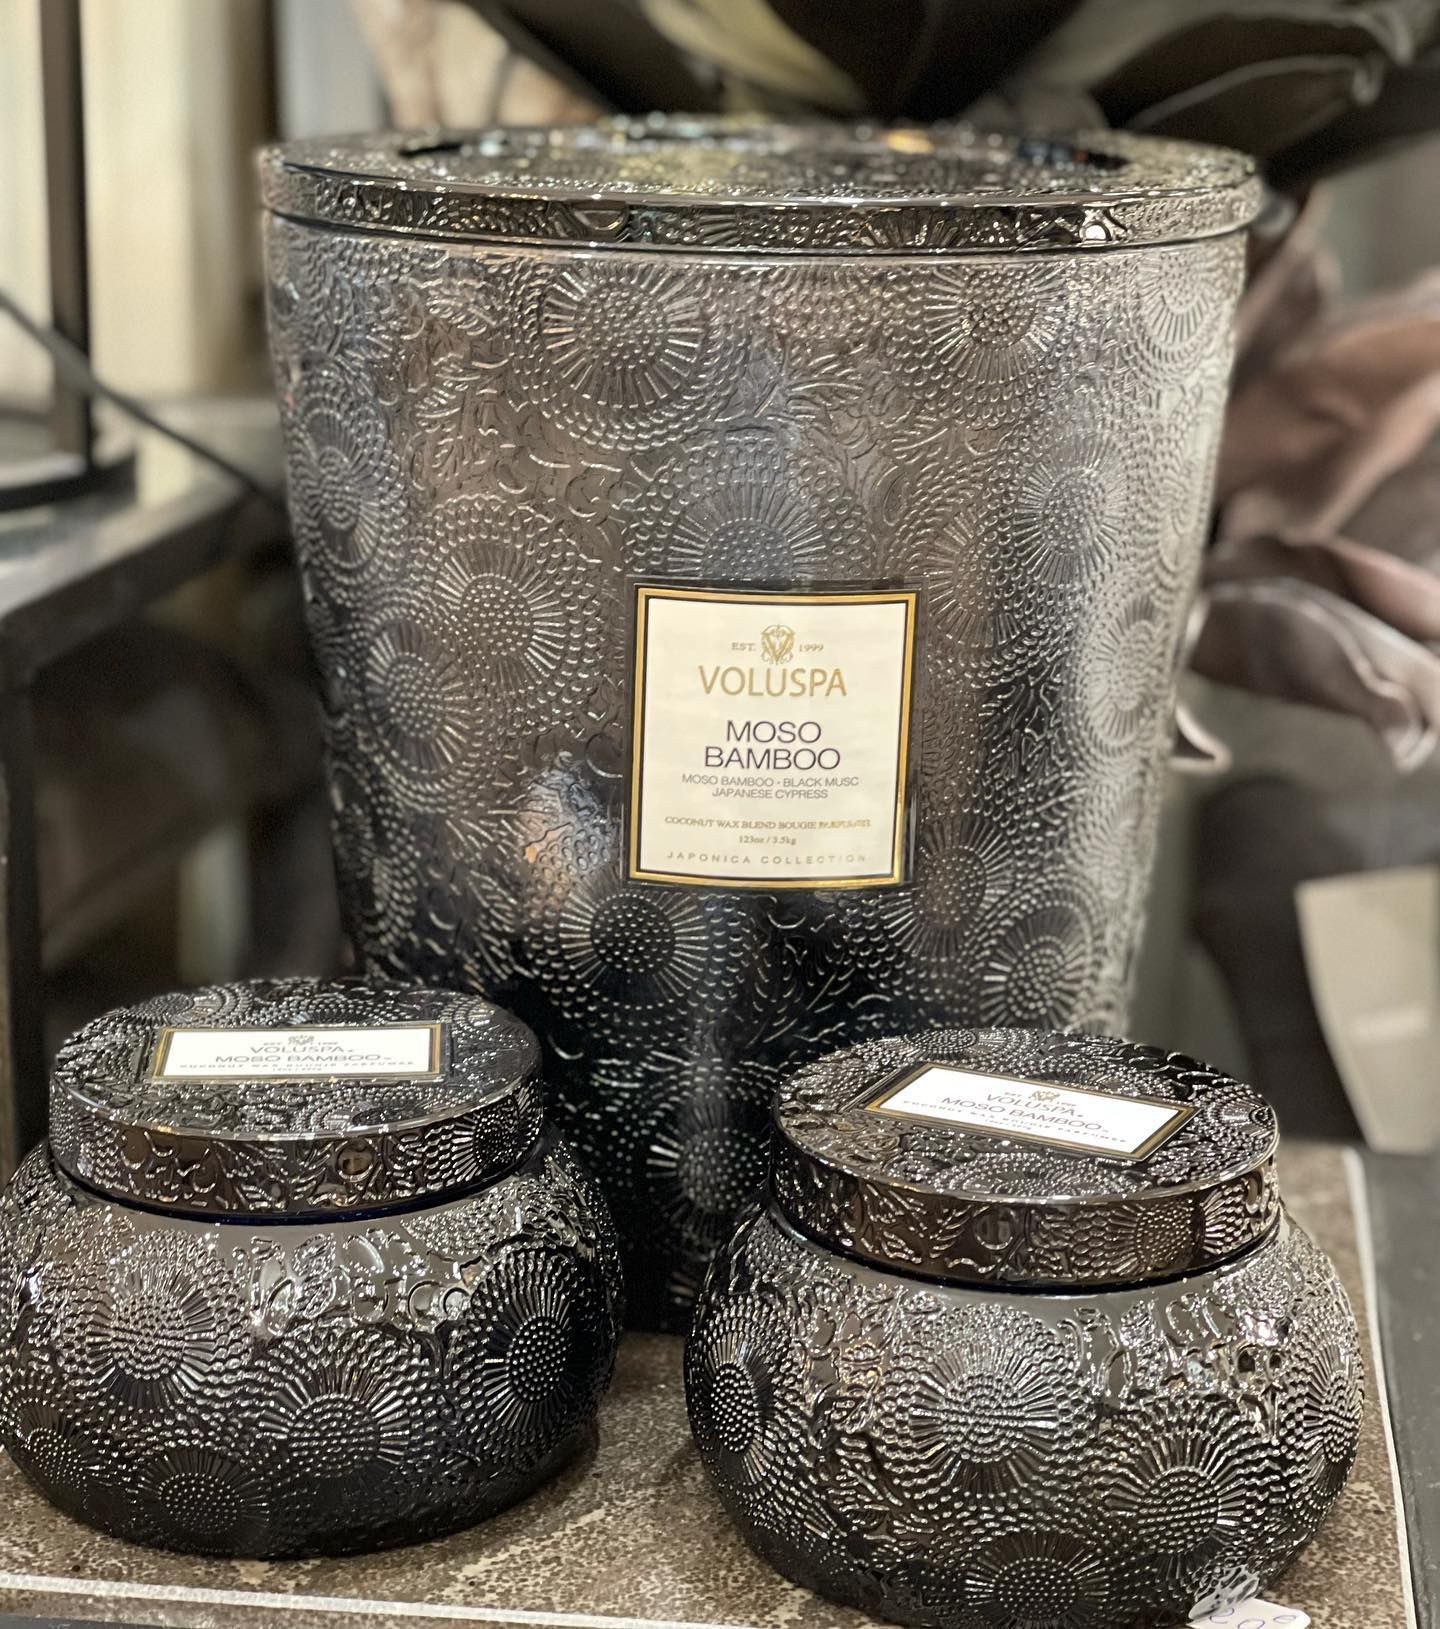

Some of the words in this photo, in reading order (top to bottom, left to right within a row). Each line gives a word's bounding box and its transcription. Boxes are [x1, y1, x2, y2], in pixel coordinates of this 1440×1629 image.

[799, 643, 824, 652] 1999
[698, 665, 847, 697] VOLUSPA
[726, 720, 822, 743] MOSO
[704, 746, 841, 770] BAMBOO
[681, 774, 718, 785] MOSO
[720, 776, 774, 787] BAMBOO
[783, 776, 822, 787] BLACK
[825, 776, 859, 787] MUSC
[712, 787, 773, 799] JAPANESE
[775, 789, 828, 800] CYPRESS
[664, 816, 714, 827] COCONUT
[716, 819, 740, 828] WAX
[741, 820, 776, 829] BLEND
[667, 850, 751, 864] JAPONICA
[760, 853, 865, 865] COLLECTION
[250, 1046, 344, 1054] VOLUSPA
[215, 1055, 281, 1063] MOSO
[287, 1054, 381, 1062] BAMBOO
[986, 1094, 1076, 1116] VOLUSPA
[941, 1097, 1006, 1112] MOSO
[1008, 1109, 1102, 1130] BAMBOO
